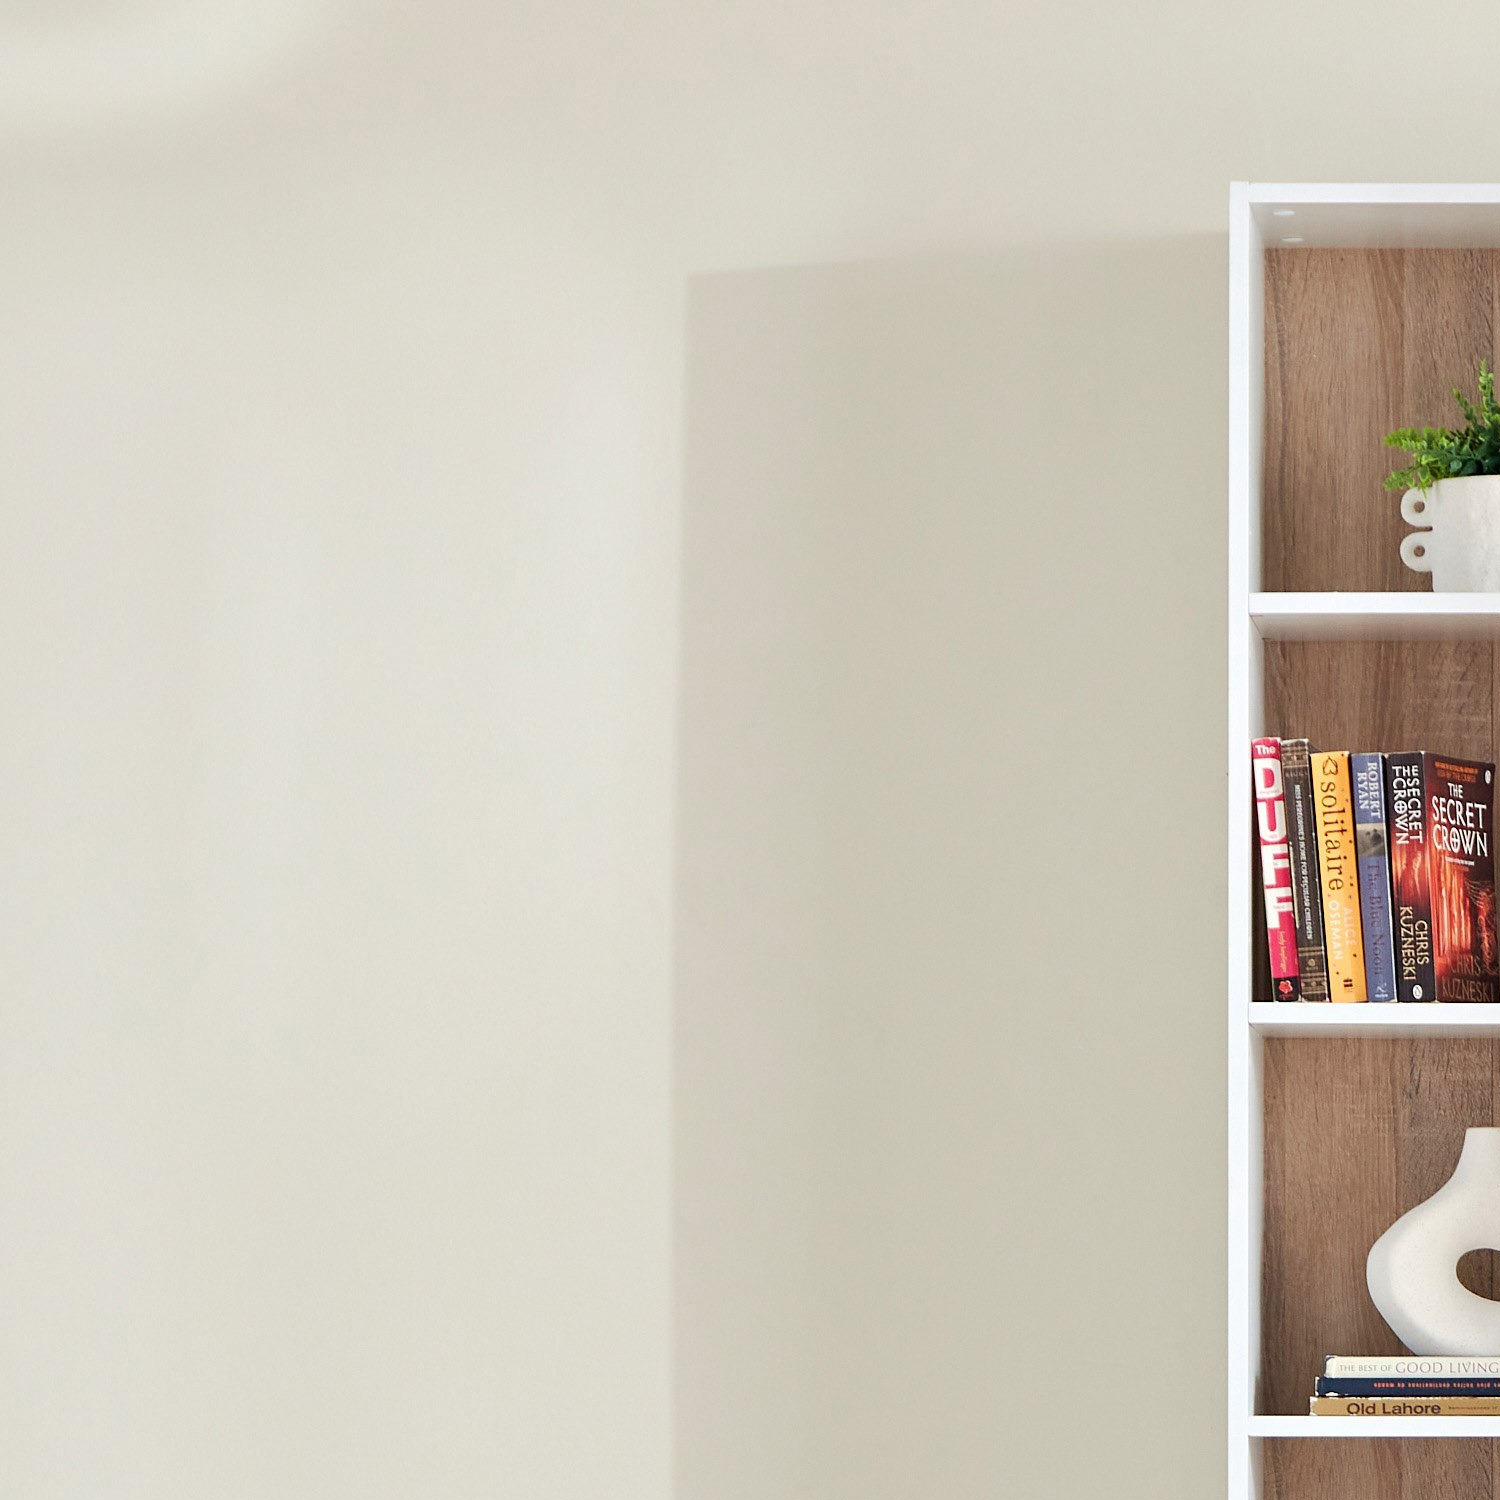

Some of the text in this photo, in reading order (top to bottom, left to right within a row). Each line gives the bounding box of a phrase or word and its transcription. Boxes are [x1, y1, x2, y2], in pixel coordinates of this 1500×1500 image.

[1255, 745, 1276, 754] The
[1367, 762, 1381, 818] ROBERT
[1392, 765, 1419, 777] THE
[1447, 782, 1464, 798] THE
[1357, 772, 1370, 810] RYAN
[1392, 778, 1410, 845] CROWN
[1406, 778, 1423, 844] SECRET
[1431, 795, 1487, 829] SECRET
[1253, 758, 1293, 928] DUFF
[1320, 782, 1347, 890] solitaire
[1432, 824, 1488, 857] CROWN
[1329, 901, 1343, 960] OSEMAN
[1343, 907, 1356, 945] ALICE
[1399, 906, 1416, 980] KUZNESKI
[1415, 921, 1430, 965] CHRIS
[1450, 954, 1481, 976] CHRIS
[1442, 976, 1494, 1003] KUZNESKI
[1339, 1364, 1357, 1372] THE
[1358, 1364, 1377, 1372] BEST
[1381, 1364, 1392, 1372] OF
[1395, 1362, 1443, 1373] GOOD
[1449, 1362, 1499, 1373] LIVING
[1346, 1402, 1441, 1415] Old Lahore
